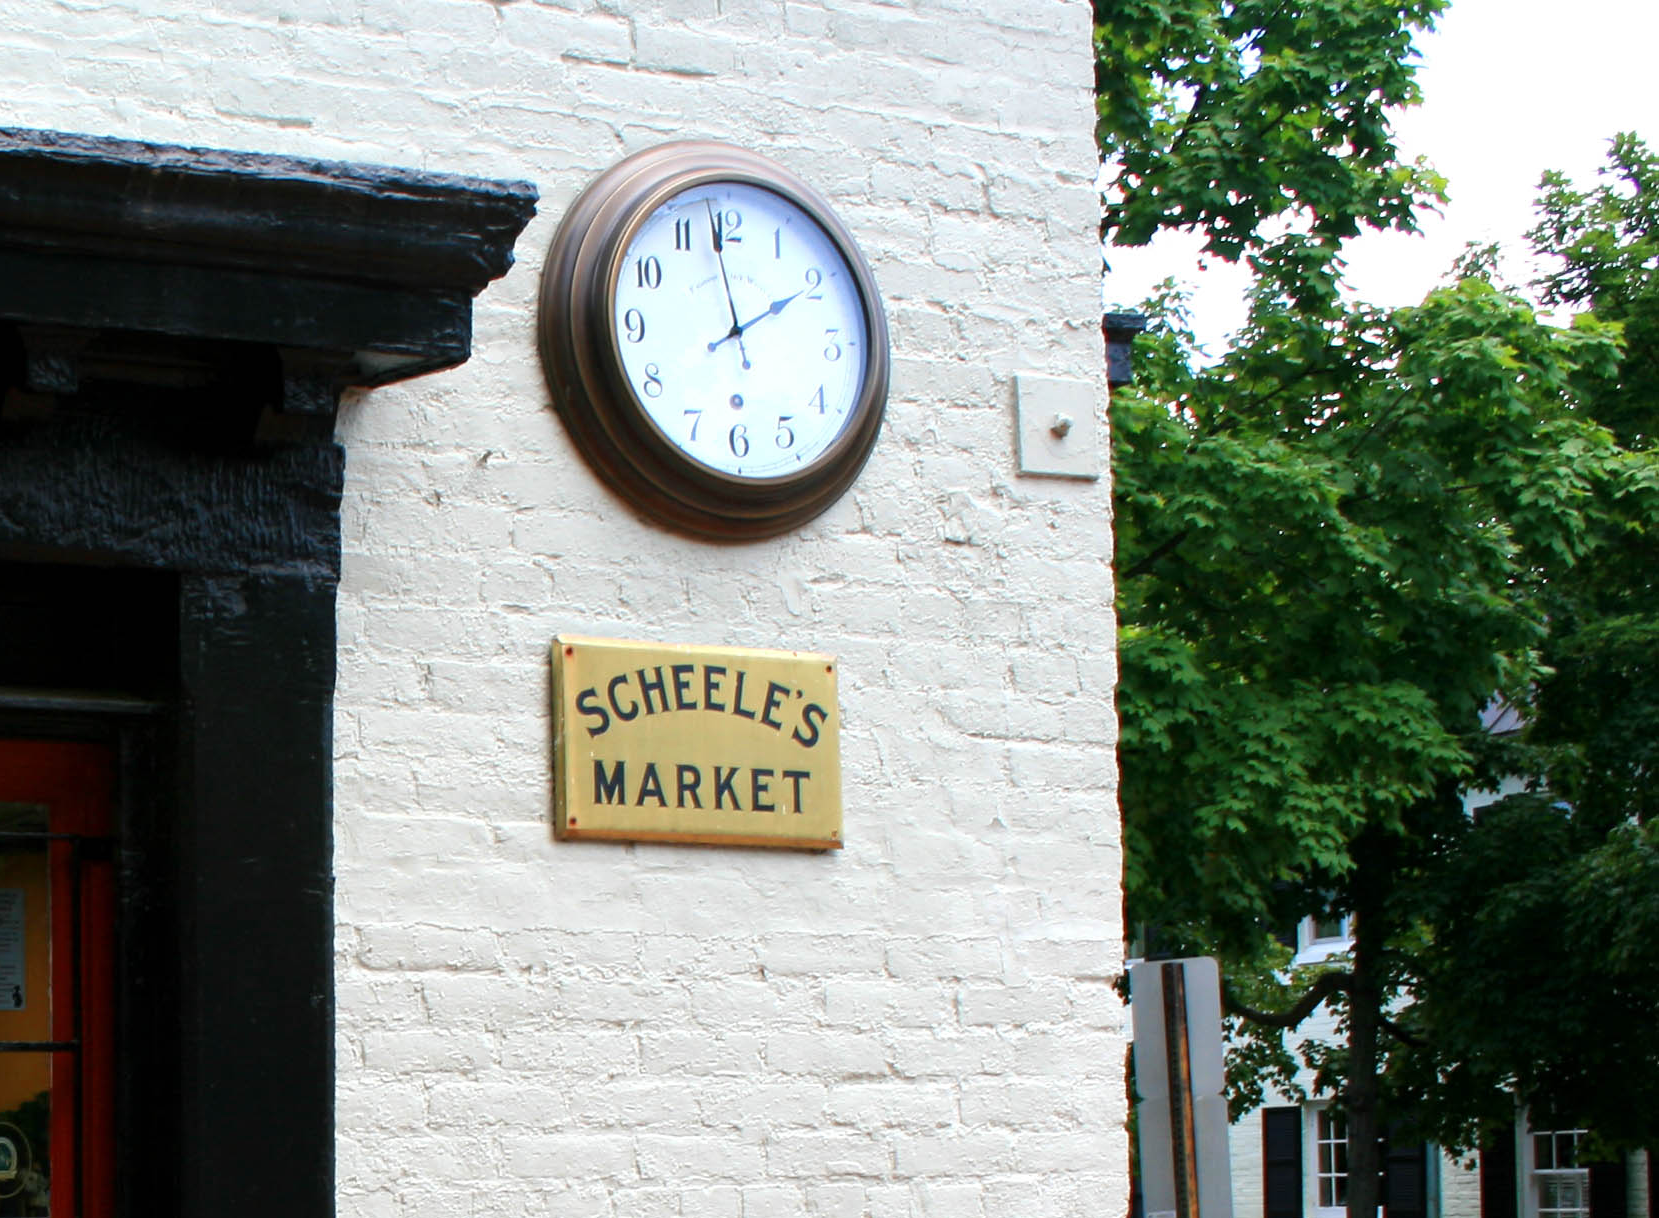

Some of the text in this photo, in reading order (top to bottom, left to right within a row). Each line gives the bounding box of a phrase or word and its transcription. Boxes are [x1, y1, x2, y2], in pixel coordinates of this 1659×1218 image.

[673, 217, 692, 252] 11
[714, 209, 743, 244] 12
[772, 226, 782, 259] 1
[636, 255, 663, 289] 10
[804, 268, 824, 301] 2
[624, 308, 646, 344] 9
[823, 328, 842, 362] 3
[643, 362, 664, 398] 8
[807, 383, 829, 415] 4
[682, 409, 703, 442] 7
[728, 423, 750, 458] 6
[774, 415, 795, 449] 5
[575, 664, 829, 749] SCHEELE'S
[593, 759, 811, 814] MARKET
